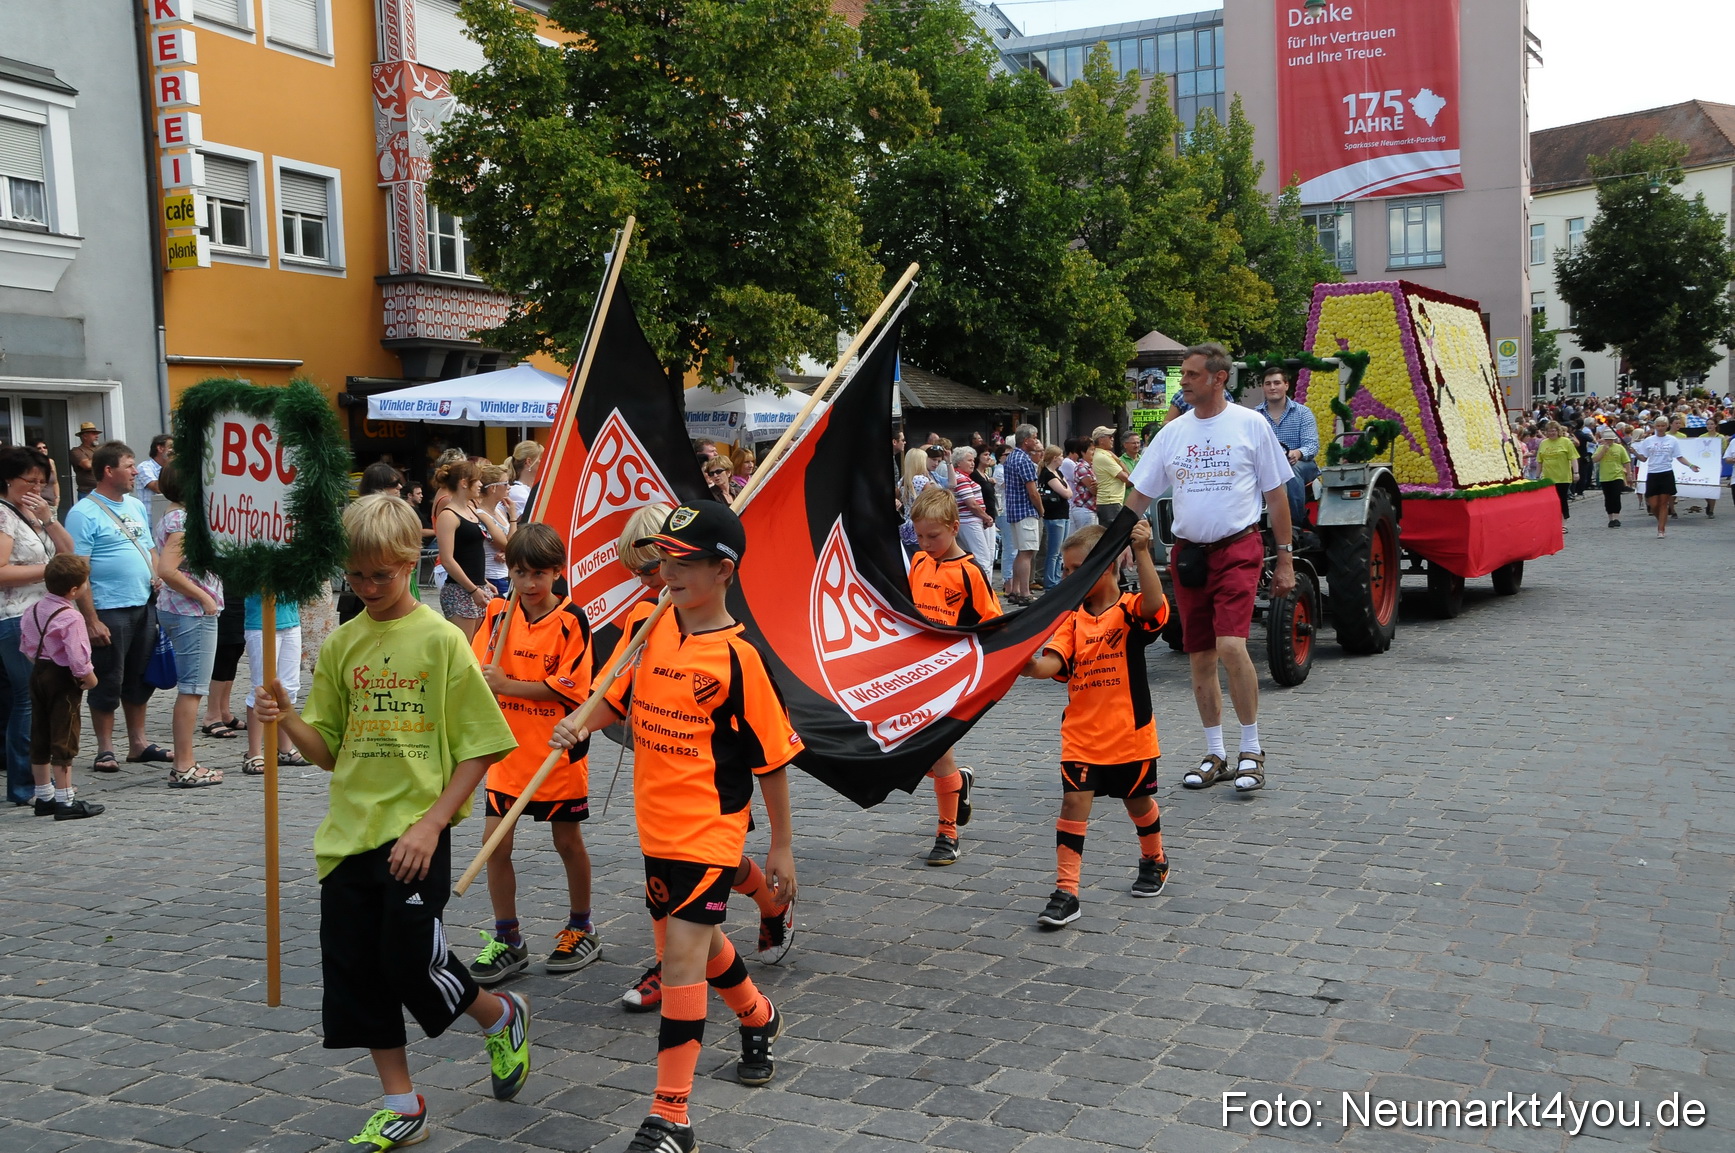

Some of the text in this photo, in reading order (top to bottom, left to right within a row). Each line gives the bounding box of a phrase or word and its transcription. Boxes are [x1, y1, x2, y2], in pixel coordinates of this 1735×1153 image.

[1288, 4, 1353, 27] Danke
[1288, 28, 1396, 48] für Ihr Vertrauen
[1288, 47, 1387, 66] und Ihre Treue.
[1343, 89, 1404, 118] 175
[1344, 115, 1404, 135] JAHRE
[1344, 135, 1446, 150] Sparkasse Neumarkt-Parsberg
[166, 199, 195, 222] café
[168, 241, 197, 264] plank
[379, 399, 439, 412] Winkler Bräu
[480, 401, 545, 414] Winkler Bräu
[711, 411, 728, 422] Bräu
[1186, 444, 1227, 457] Kinder
[1201, 457, 1230, 469] Turn
[1175, 468, 1236, 481] Olympiade
[209, 491, 300, 547] Woffenba
[577, 541, 619, 578] Woffenb
[587, 597, 607, 621] 950
[513, 649, 538, 660] saller
[352, 665, 420, 690] Kinder
[652, 666, 687, 681] saller
[846, 662, 938, 704] Woffenbach
[373, 691, 425, 714] Turn
[350, 714, 435, 736] lympiade
[642, 719, 694, 740] Kollmann
[649, 876, 670, 903] 9
